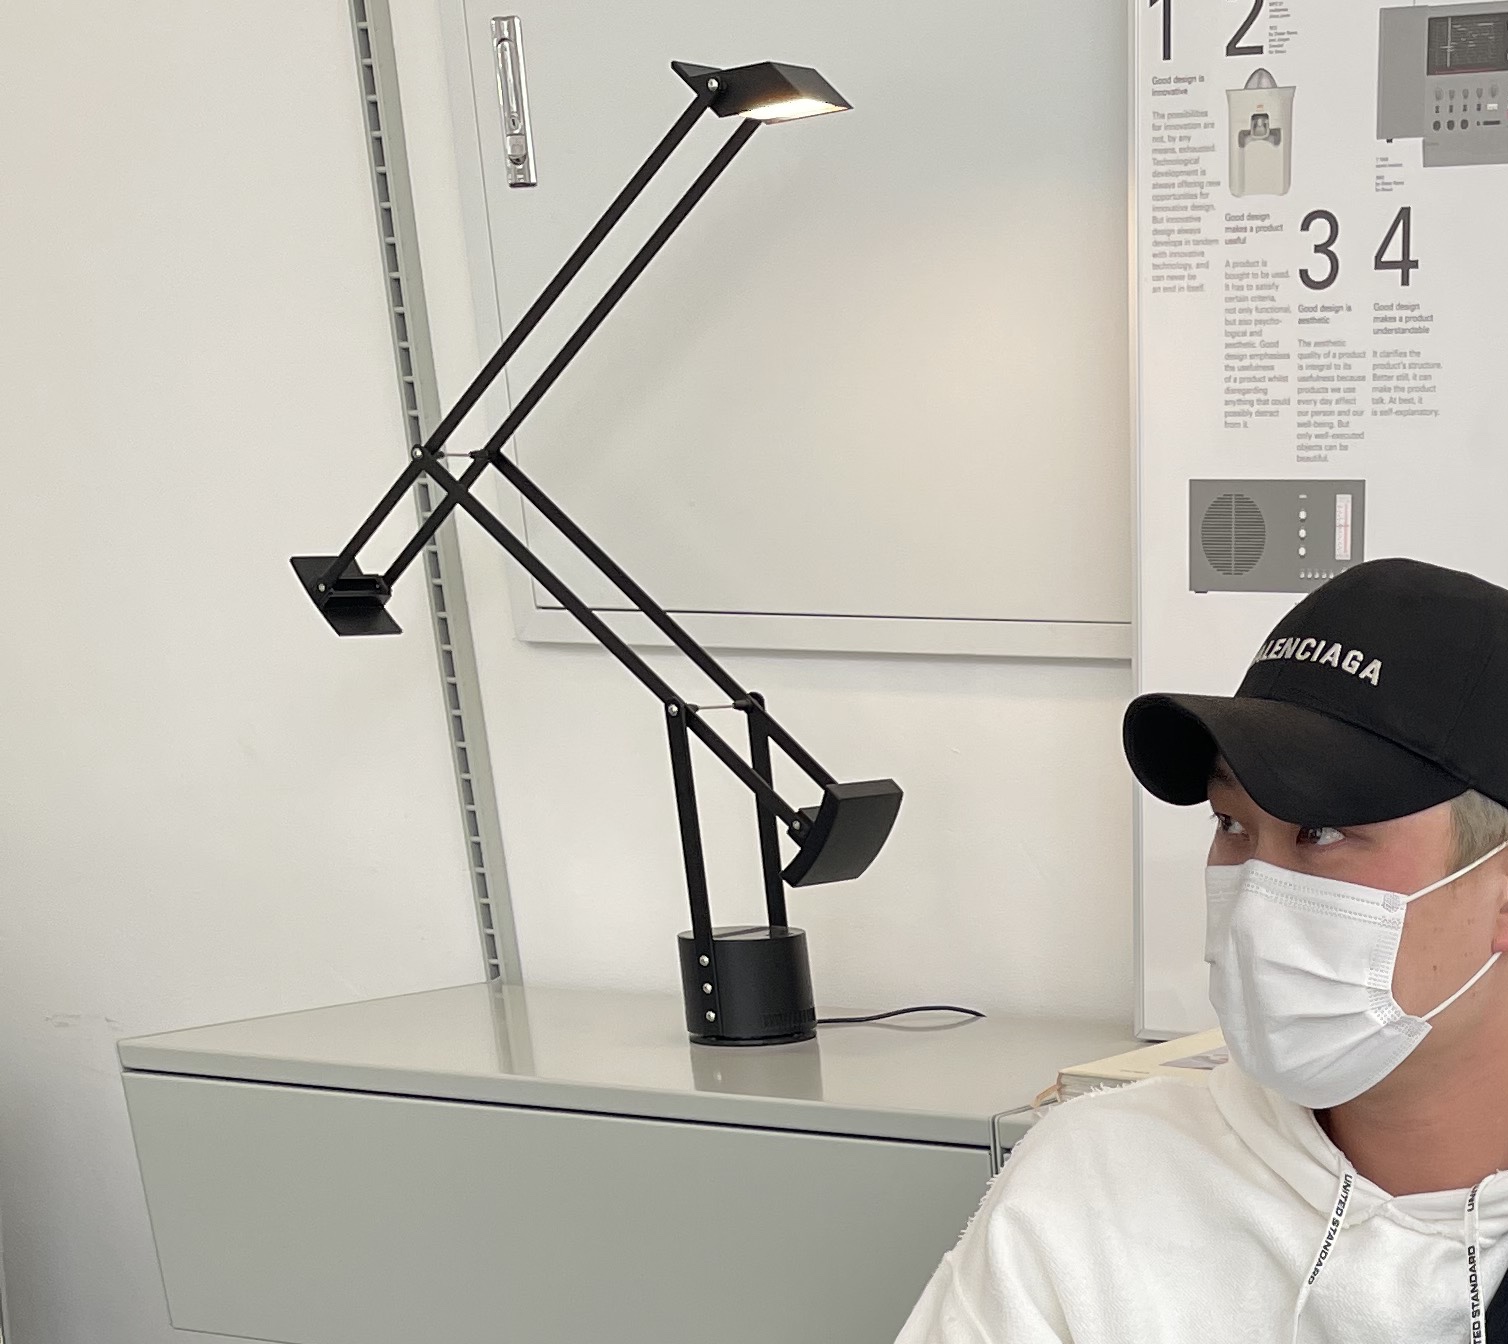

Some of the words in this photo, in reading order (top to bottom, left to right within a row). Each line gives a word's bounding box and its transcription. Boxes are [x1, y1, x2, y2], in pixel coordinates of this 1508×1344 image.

[1226, 0, 1264, 57] 2
[1152, 76, 1172, 85] Good
[1199, 74, 1204, 83] is
[1225, 213, 1244, 222] Good
[1255, 223, 1284, 234] product
[1299, 209, 1339, 290] 3
[1374, 206, 1419, 286] 4
[1298, 304, 1318, 313] Good
[1373, 302, 1394, 311] Good
[1405, 314, 1434, 324] product
[1254, 637, 1382, 687] ALENCIAGA
[1335, 1173, 1353, 1217] UNITED
[1308, 1217, 1340, 1285] STANDARD
[1468, 1245, 1480, 1319] STANDARD
